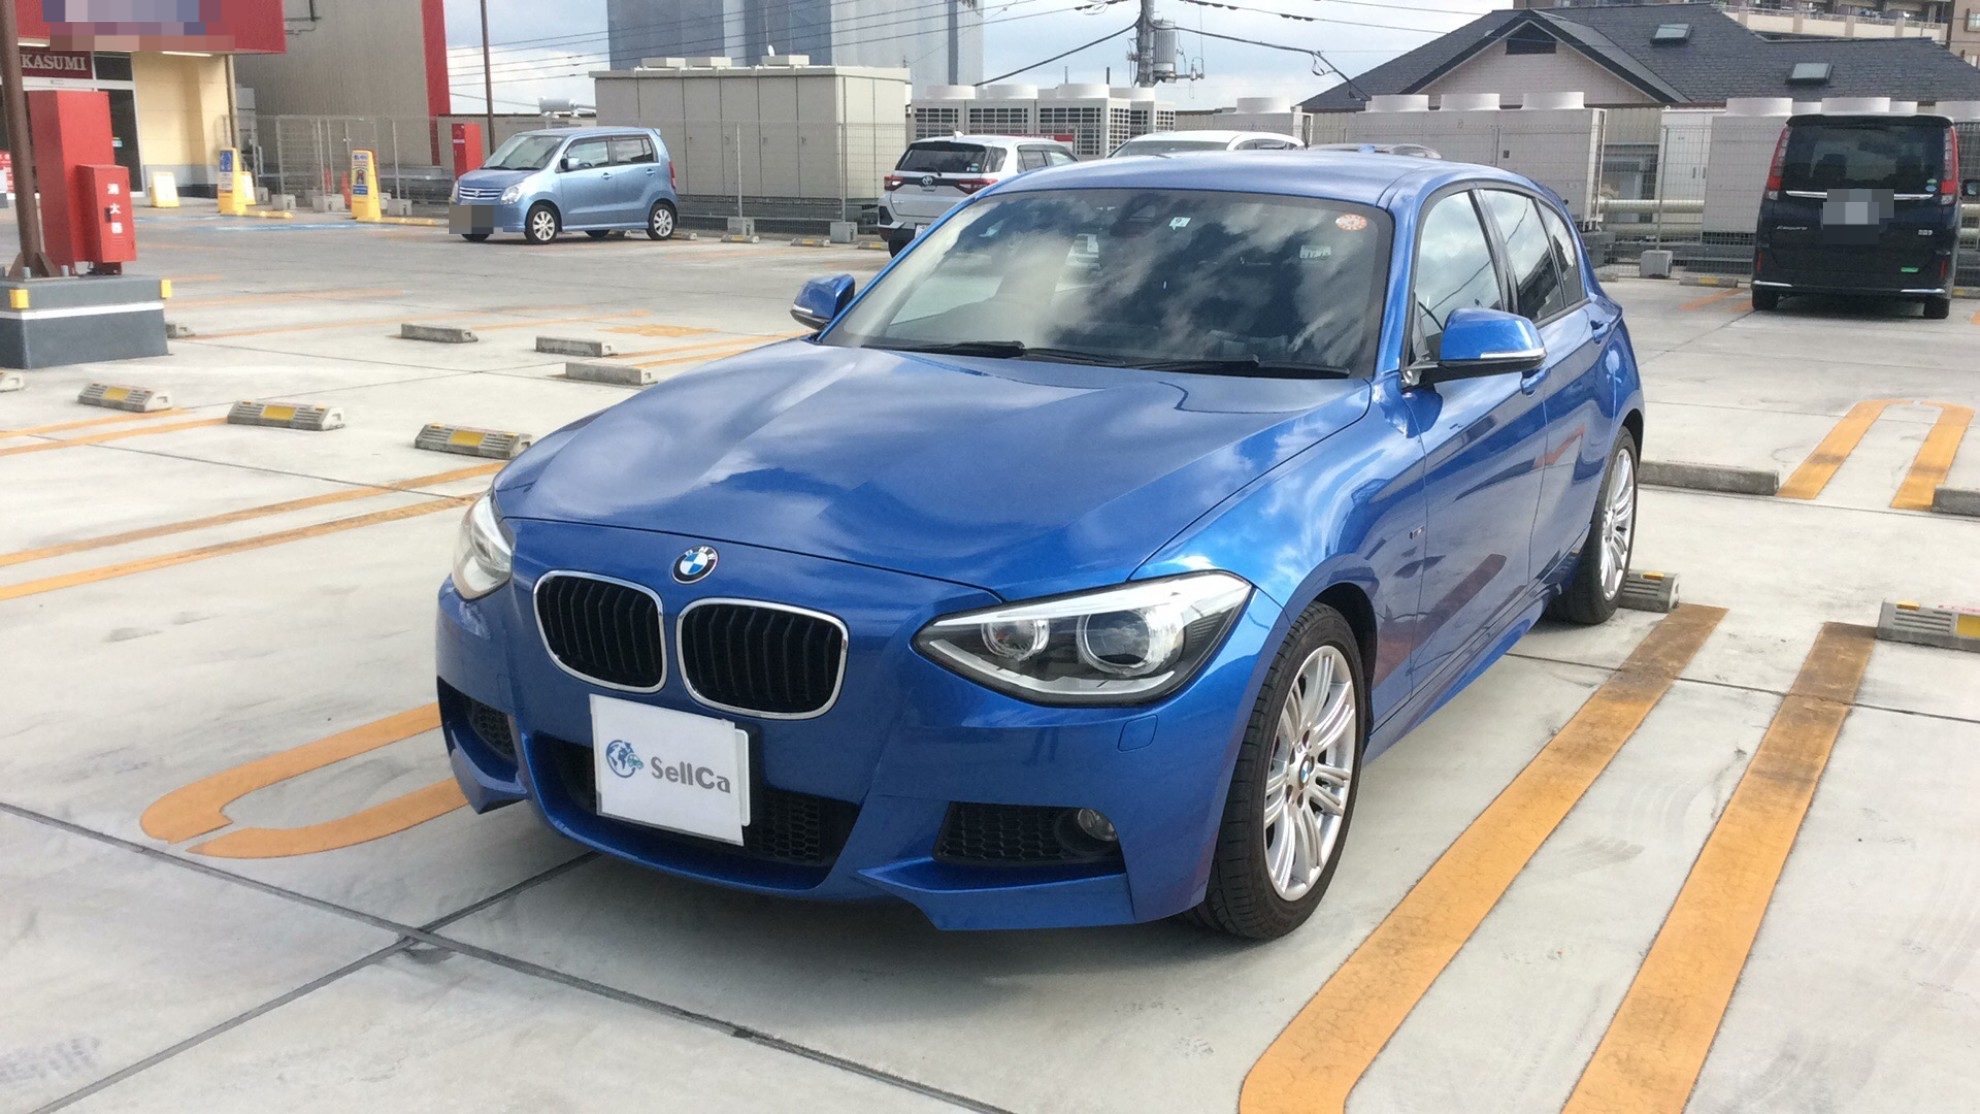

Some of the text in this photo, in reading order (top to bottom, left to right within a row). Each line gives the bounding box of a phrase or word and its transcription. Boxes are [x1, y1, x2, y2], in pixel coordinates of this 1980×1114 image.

[21, 54, 87, 71] KASUMI
[684, 545, 716, 561] BMW
[650, 756, 731, 794] SellCa
